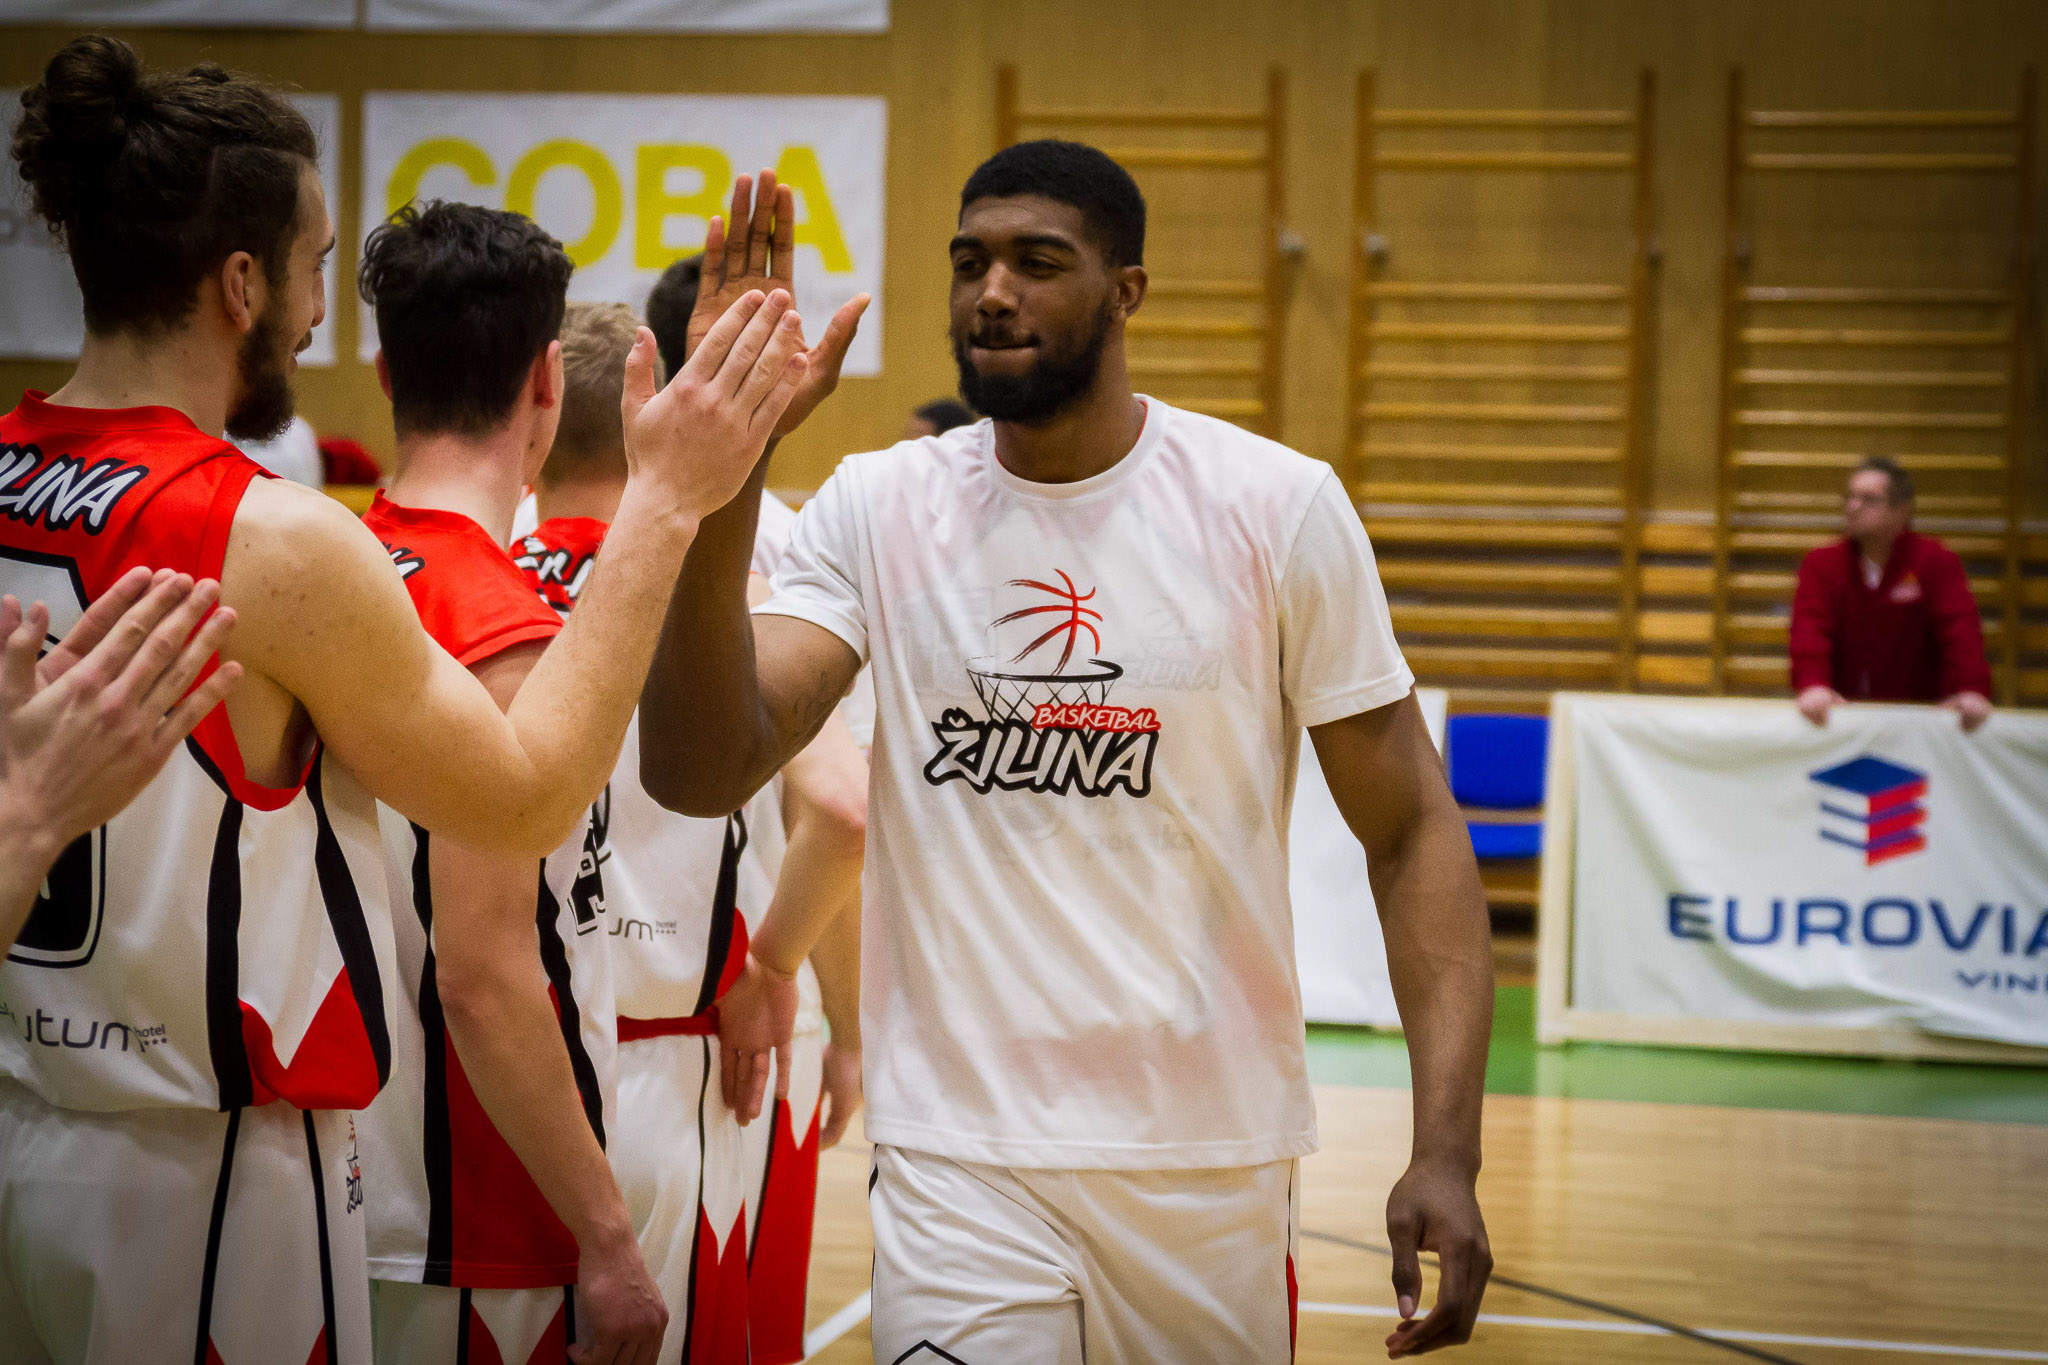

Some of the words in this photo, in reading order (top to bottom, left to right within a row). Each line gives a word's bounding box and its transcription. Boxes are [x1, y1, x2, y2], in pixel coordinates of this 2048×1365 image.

[1034, 703, 1160, 732] BASKETBAL
[925, 707, 1158, 797] ŽILINA
[1957, 968, 2048, 995] VIN
